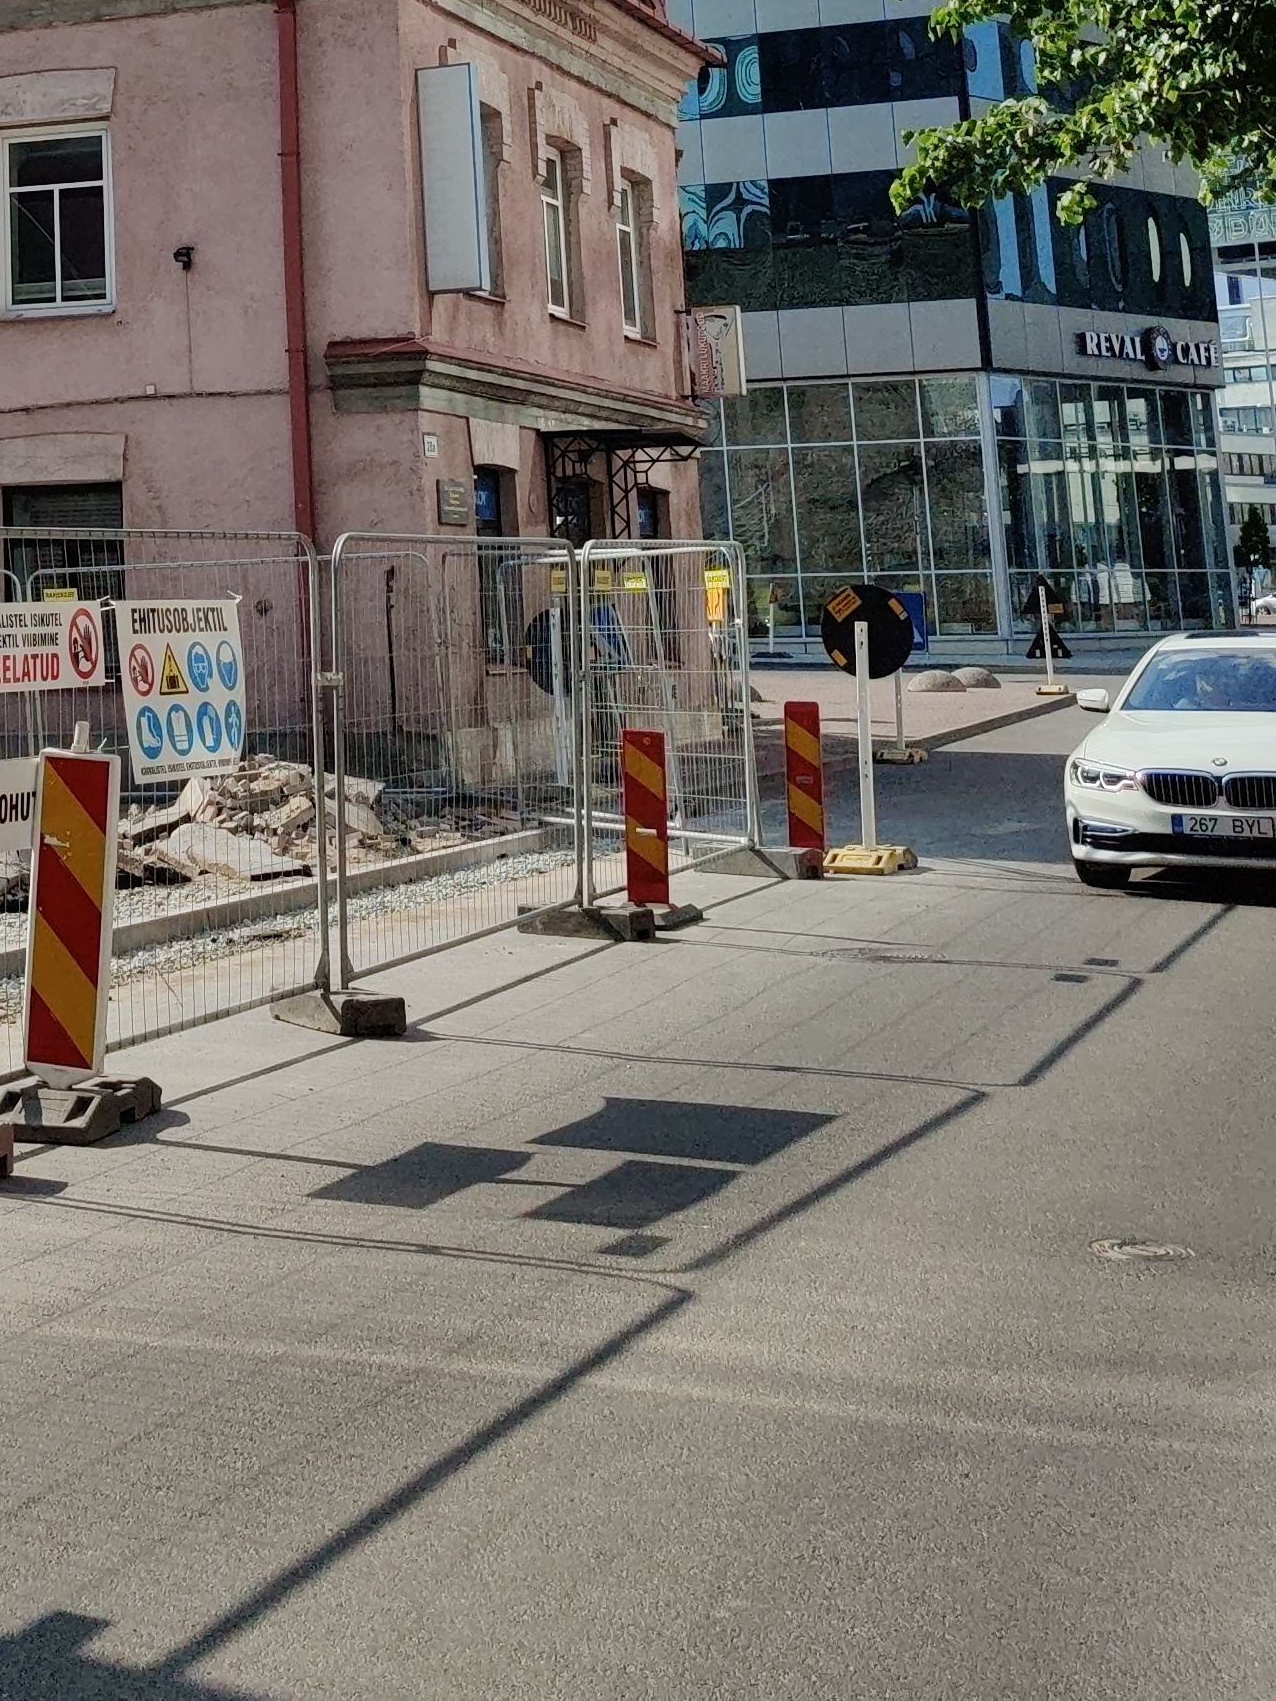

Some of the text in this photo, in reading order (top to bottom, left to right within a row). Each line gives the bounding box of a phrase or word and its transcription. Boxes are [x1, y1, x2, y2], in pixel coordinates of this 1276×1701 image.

[1085, 331, 1145, 361] REVAL
[1176, 339, 1220, 368] CAFÉ
[30, 612, 63, 628] ISIKUTEL
[131, 607, 228, 634] EHITUSOBJEKTIL
[21, 631, 59, 647] VIIBIMINE
[1188, 817, 1268, 835] 267 BYL
